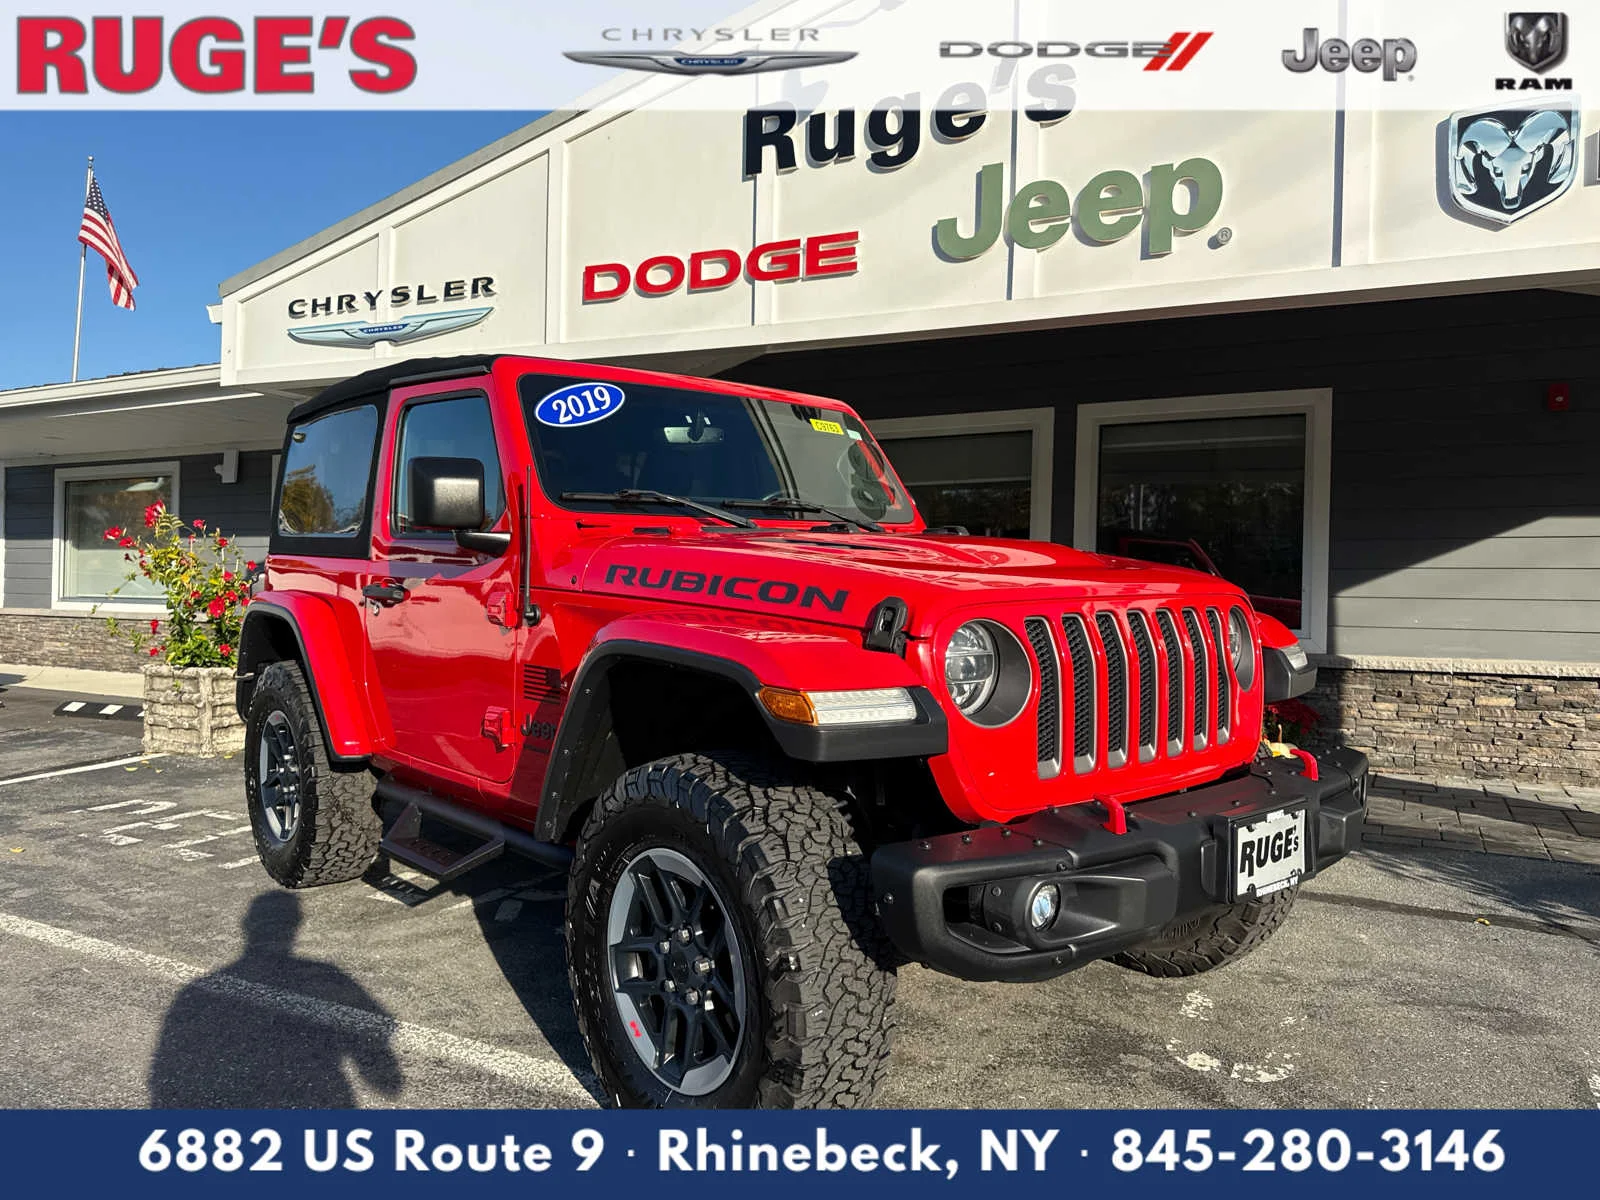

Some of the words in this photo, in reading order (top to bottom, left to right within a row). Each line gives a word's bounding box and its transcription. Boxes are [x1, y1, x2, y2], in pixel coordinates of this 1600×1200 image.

[743, 56, 1077, 176] Ruge's
[936, 155, 1224, 257] Jeep
[583, 231, 859, 303] DODGE
[288, 276, 496, 319] CHRYSLER
[552, 386, 611, 423] 2019
[604, 564, 849, 613] RUBICON
